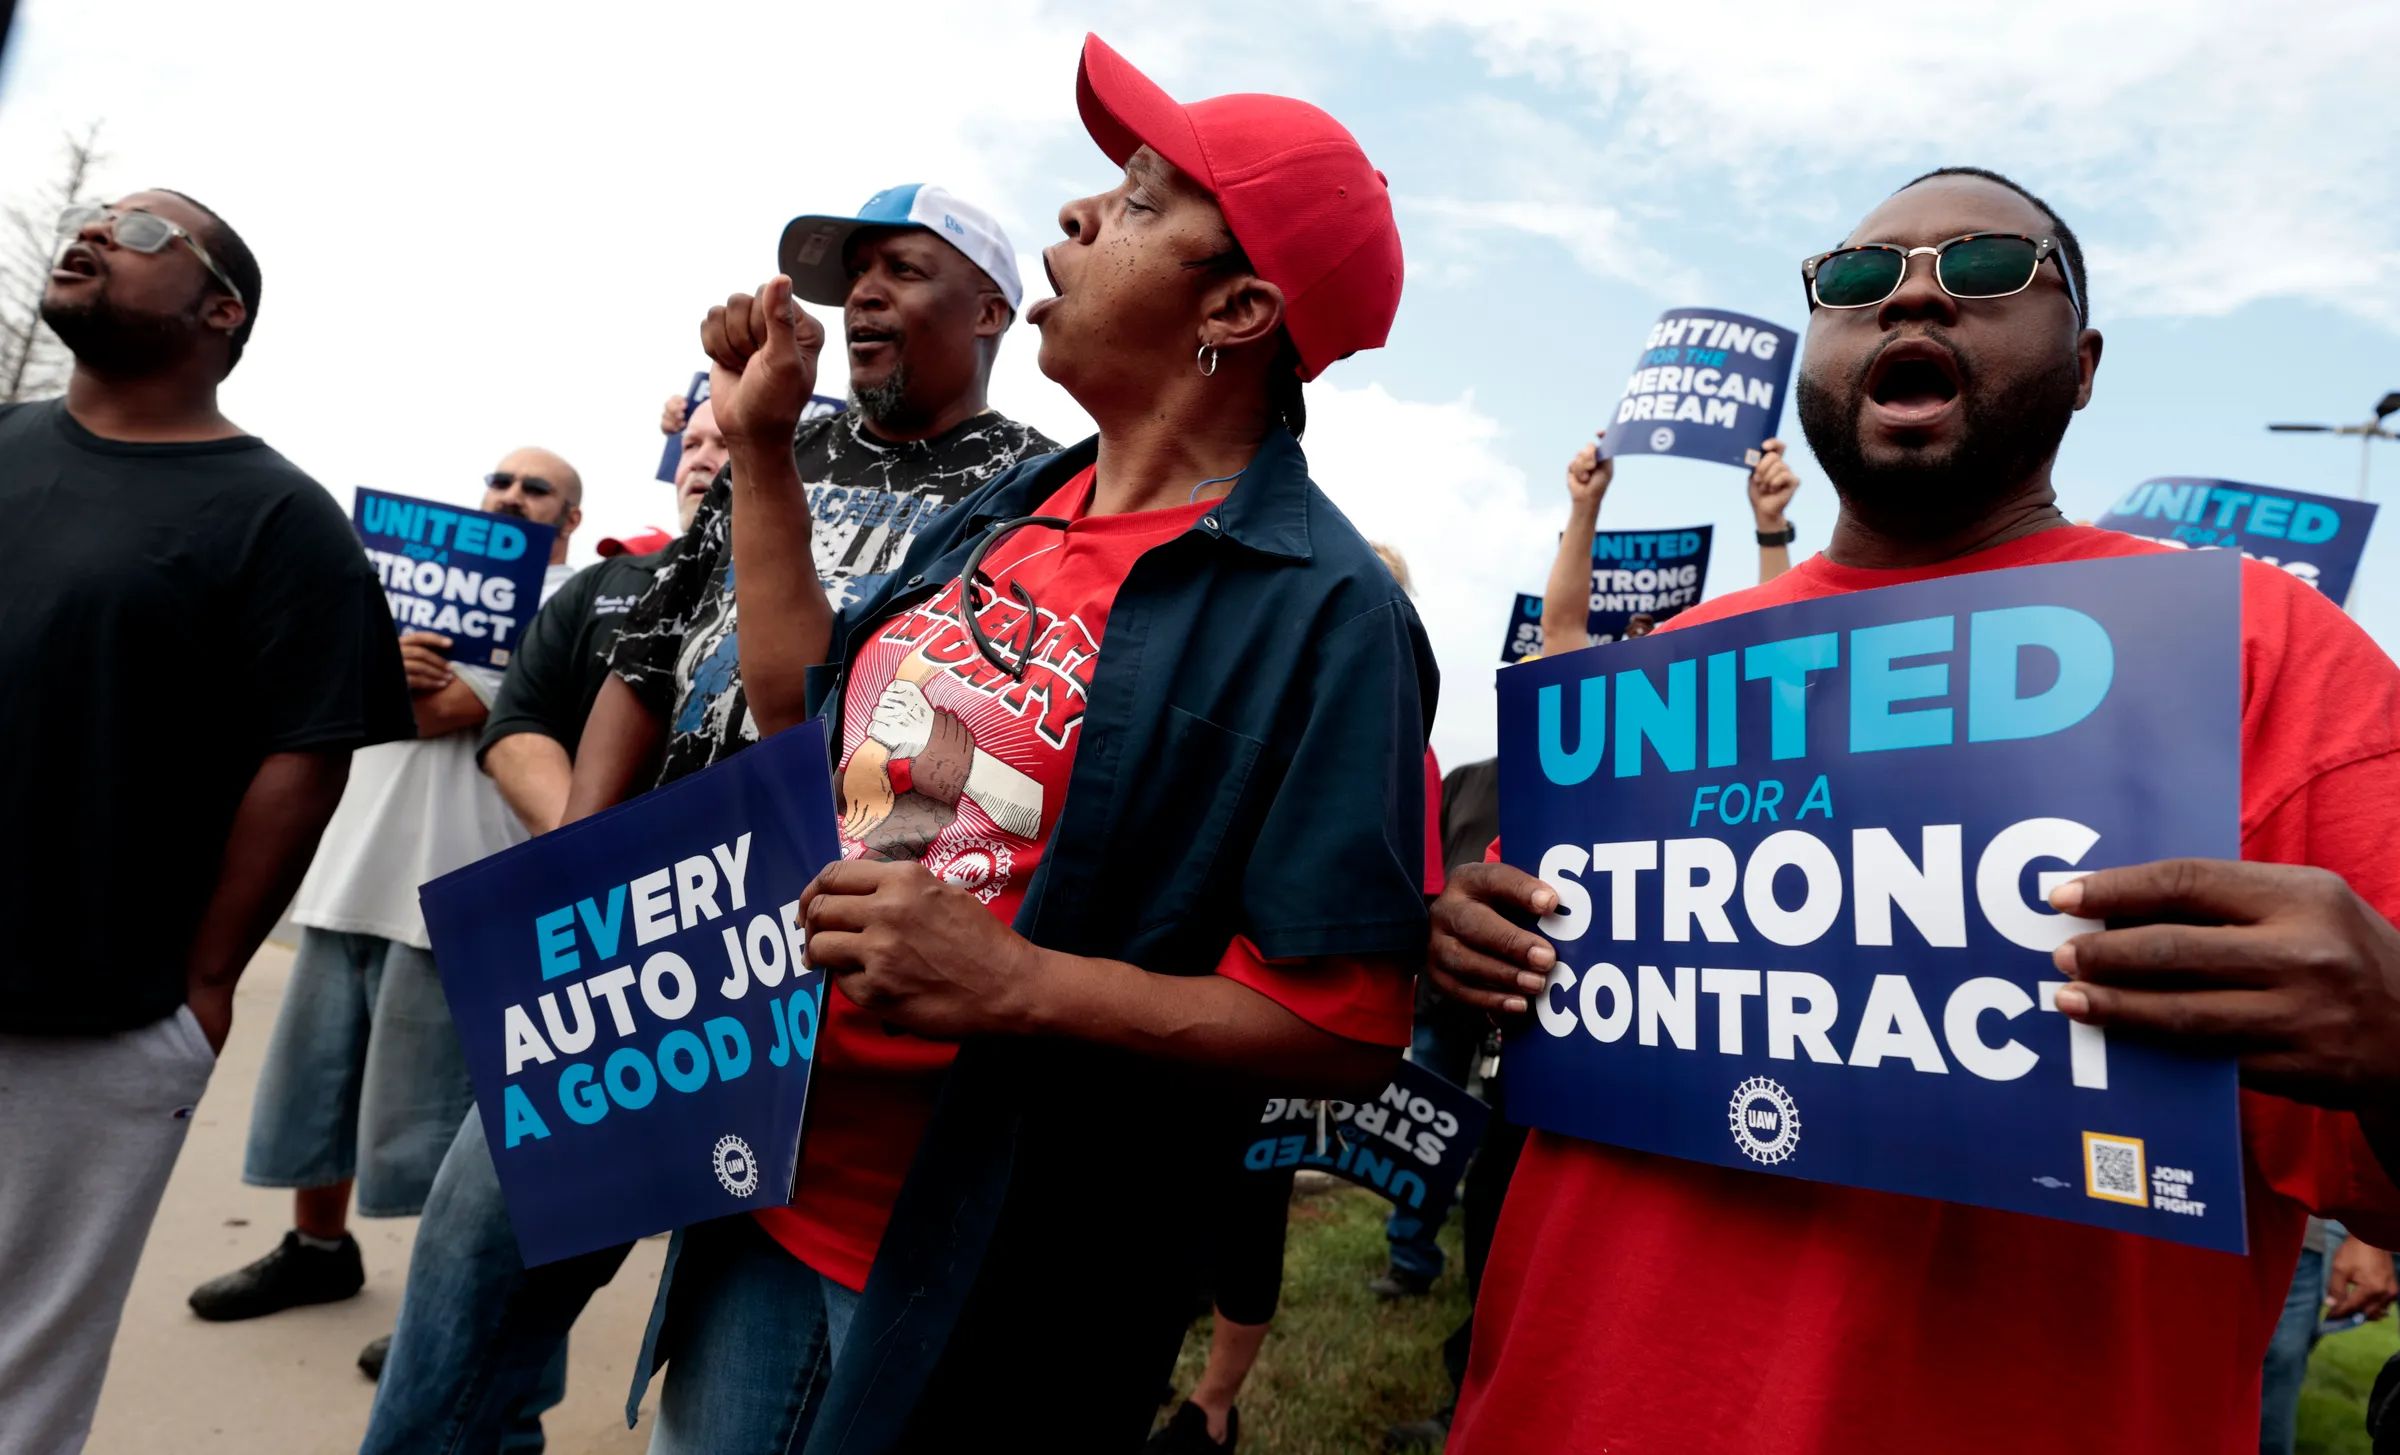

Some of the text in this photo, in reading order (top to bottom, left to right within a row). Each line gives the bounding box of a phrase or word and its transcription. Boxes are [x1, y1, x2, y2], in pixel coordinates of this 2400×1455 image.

[1686, 349, 1728, 367] THE
[1617, 394, 1739, 429] DREAM
[1622, 366, 1774, 410] MERICAN
[364, 496, 527, 561] UNITED
[2110, 483, 2340, 544] UNITED
[1589, 587, 1696, 612] ONTRACT
[1590, 565, 1697, 593] TRONG
[1538, 606, 2114, 786] UNITED
[1690, 775, 1834, 828] FOR A
[535, 832, 753, 981] EVERY
[1537, 817, 2106, 952] STRONG
[505, 951, 697, 1076] AUTO
[1536, 961, 2108, 1090] CONTRACT
[505, 983, 822, 1149] A GOOD JO
[1748, 1109, 1777, 1131] UAW
[726, 1158, 745, 1174] UAW
[1243, 1135, 1427, 1208] UNITED
[2152, 1166, 2194, 1185] JOIN
[2152, 1180, 2188, 1199] THE
[2153, 1195, 2206, 1217] FIGHT
